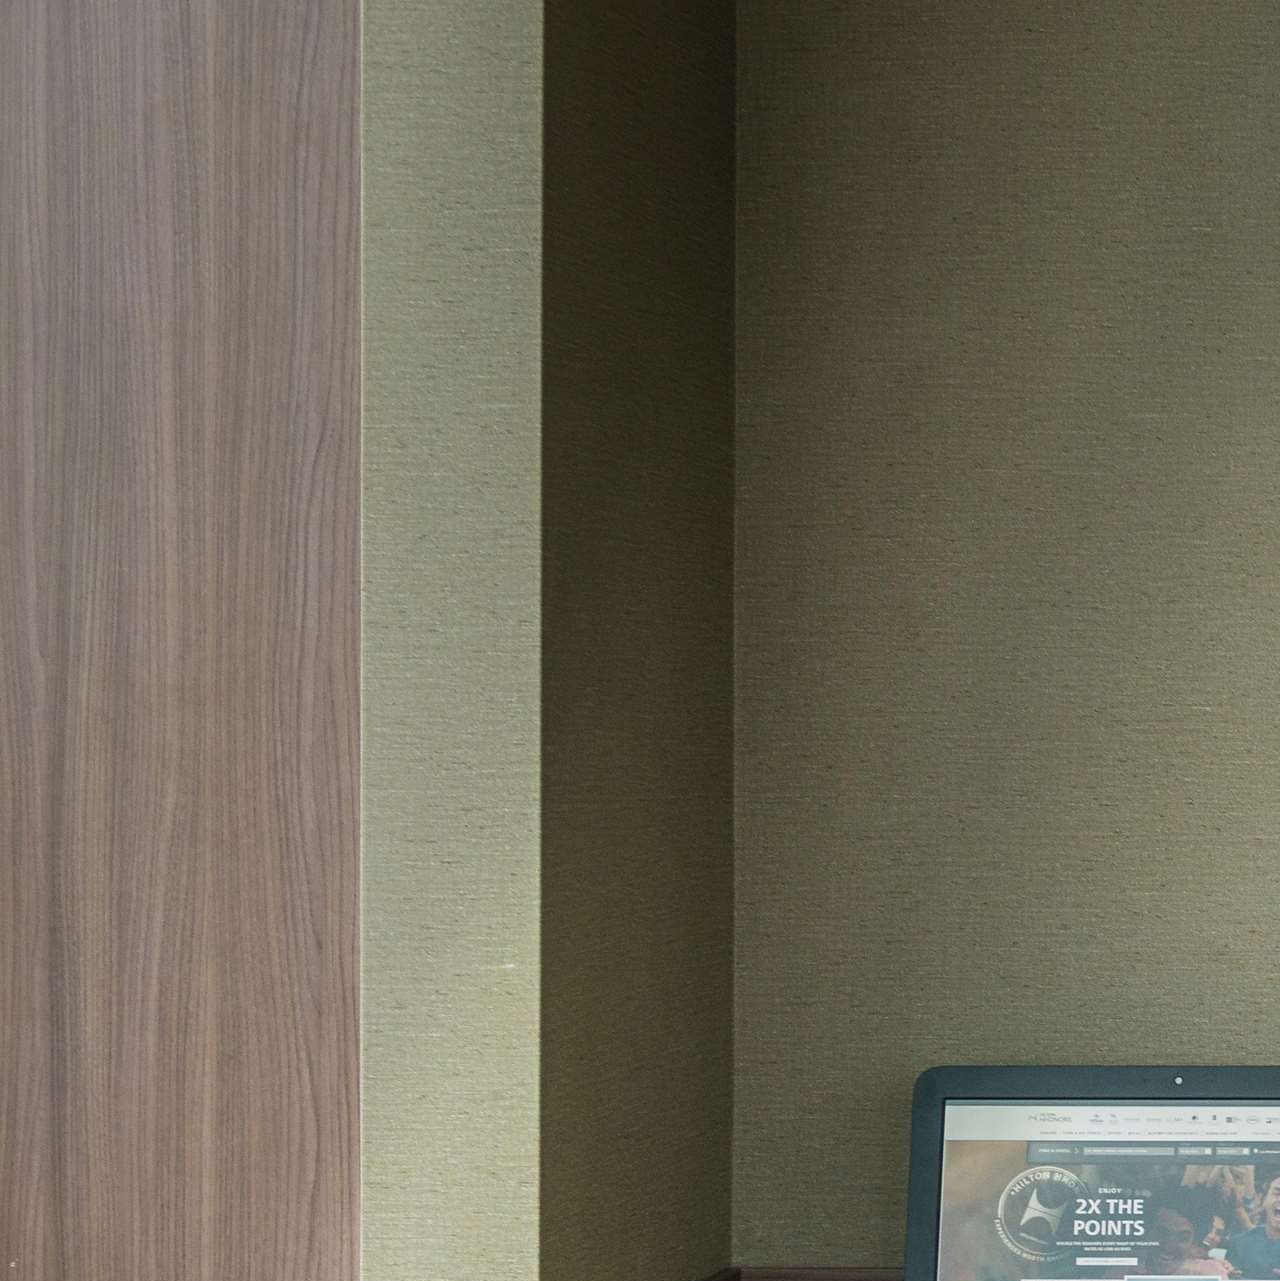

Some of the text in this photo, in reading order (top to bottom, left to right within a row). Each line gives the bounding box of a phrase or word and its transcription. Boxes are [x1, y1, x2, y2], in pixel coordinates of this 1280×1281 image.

[1013, 1171, 1051, 1193] HILTON
[1075, 1198, 1144, 1215] 2X THE
[1073, 1220, 1145, 1236] POINTS
